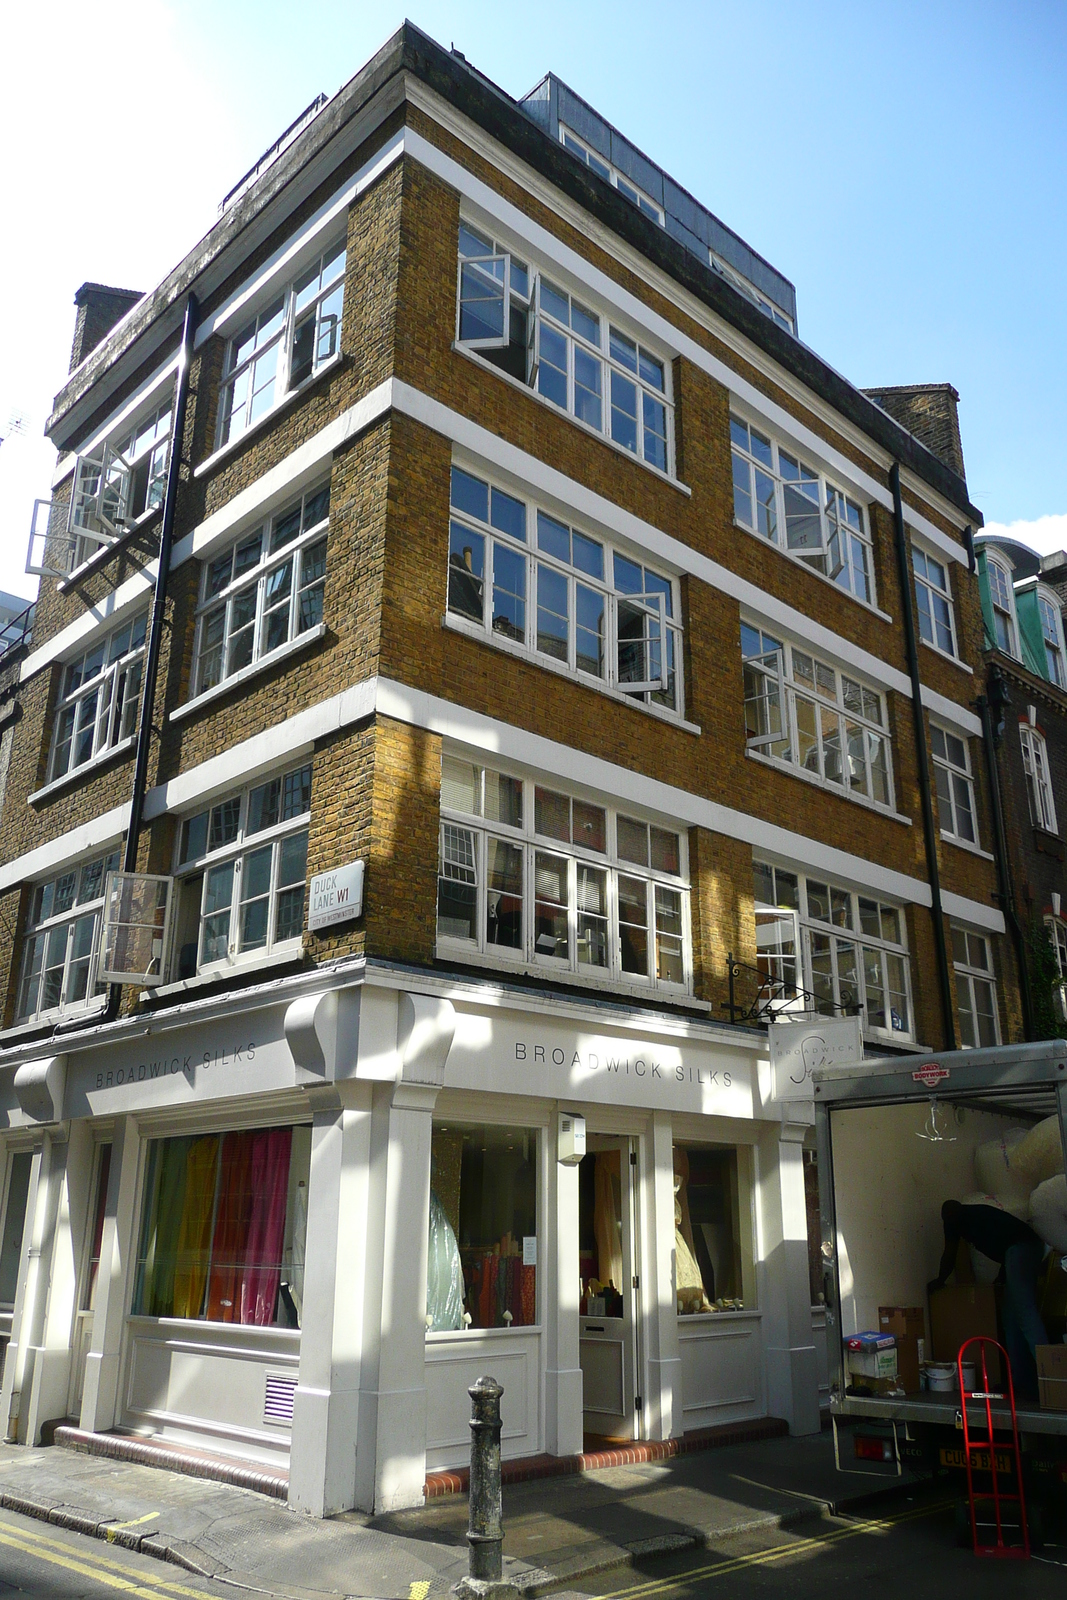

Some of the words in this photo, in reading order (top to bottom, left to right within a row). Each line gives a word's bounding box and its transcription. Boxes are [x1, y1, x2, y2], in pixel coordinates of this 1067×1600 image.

[314, 874, 338, 895] DUCK
[313, 892, 334, 911] LANE
[337, 887, 349, 903] W1
[777, 1045, 854, 1057] BROADWICK
[96, 1055, 192, 1089] BROADWICK
[202, 1042, 256, 1069] SILKS
[515, 1042, 662, 1079] BROADWICK
[675, 1065, 732, 1088] SILKS
[914, 1070, 947, 1079] BODYWORK
[899, 1447, 923, 1457] VECO
